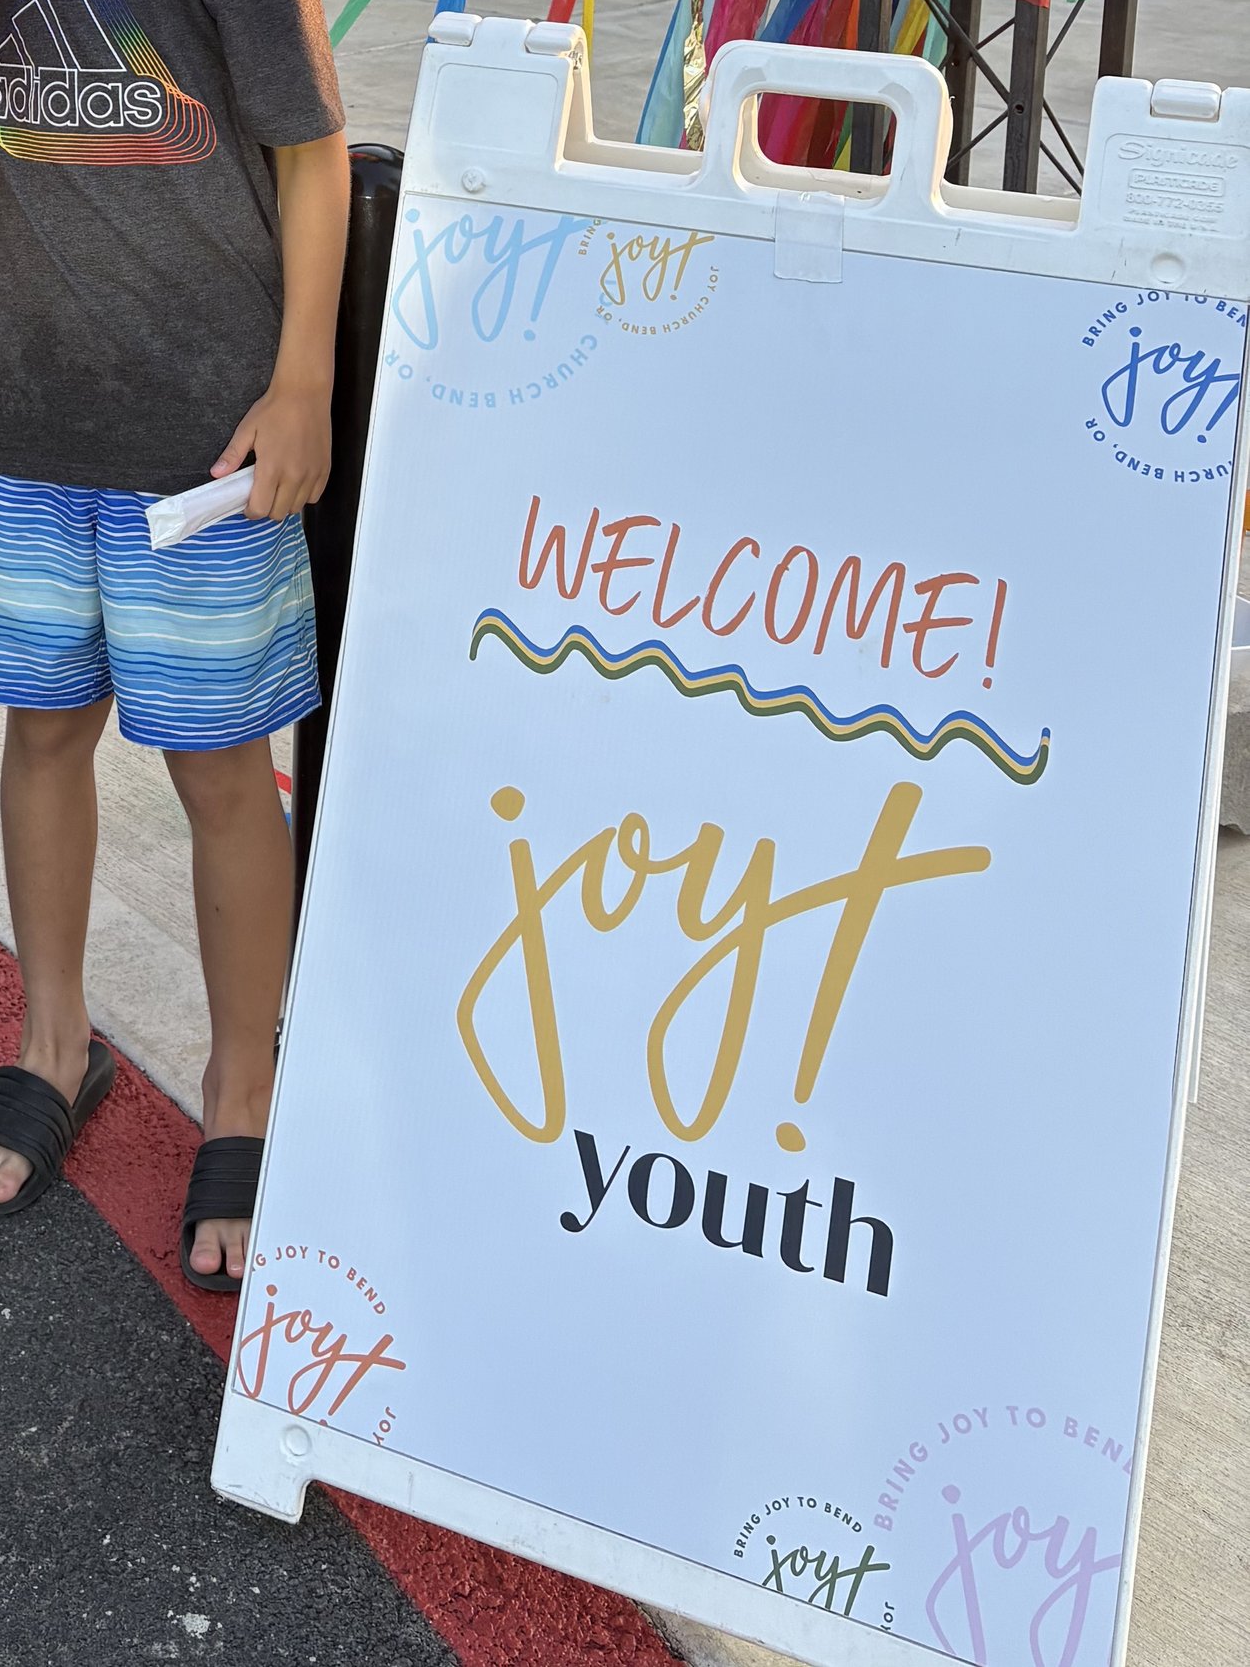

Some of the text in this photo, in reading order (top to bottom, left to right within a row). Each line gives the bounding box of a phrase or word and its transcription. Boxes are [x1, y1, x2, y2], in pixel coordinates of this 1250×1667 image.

[1117, 141, 1238, 170] Signicade
[577, 218, 602, 256] BRING
[707, 265, 719, 292] JOY
[596, 305, 613, 322] OR
[662, 296, 709, 334] CHURCH
[1082, 301, 1128, 347] BRING
[384, 348, 414, 381] OR
[509, 333, 599, 407] CHURCH
[1085, 417, 1106, 442] OR
[1173, 460, 1232, 483] URCH
[518, 494, 1008, 690] WELCOME!
[559, 1128, 895, 1297] youth
[275, 1245, 387, 1316] JOY TO BEND
[372, 1406, 397, 1446] JOY
[873, 1440, 929, 1532] BRING
[937, 1406, 989, 1444] JOY
[1005, 1404, 1047, 1429] TO
[733, 1496, 863, 1559] BRING JOY TO BEND
